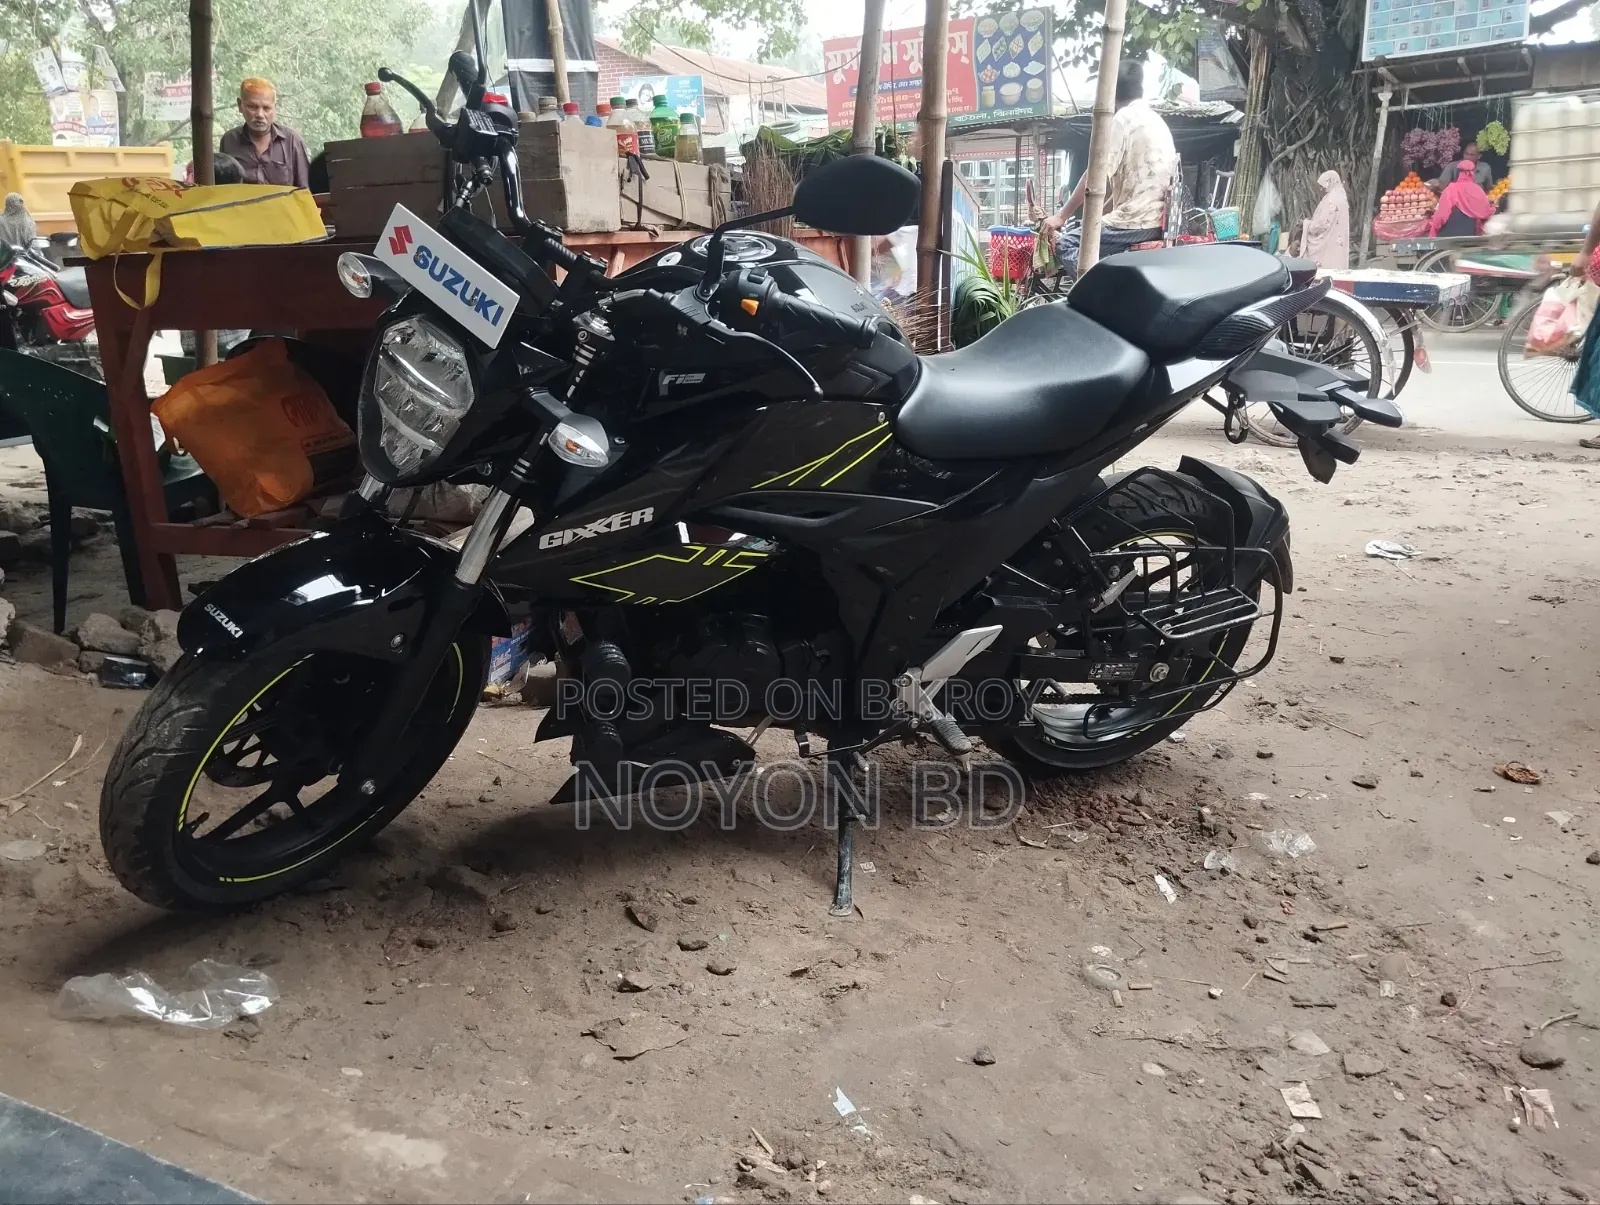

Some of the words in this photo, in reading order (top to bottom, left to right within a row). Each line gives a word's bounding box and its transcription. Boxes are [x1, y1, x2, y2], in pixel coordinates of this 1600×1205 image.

[826, 40, 899, 84] মুসম
[901, 31, 969, 74] সুস্
[413, 245, 505, 327] SUZUKI
[539, 506, 655, 550] GIXXER
[204, 603, 244, 638] SUZUKI
